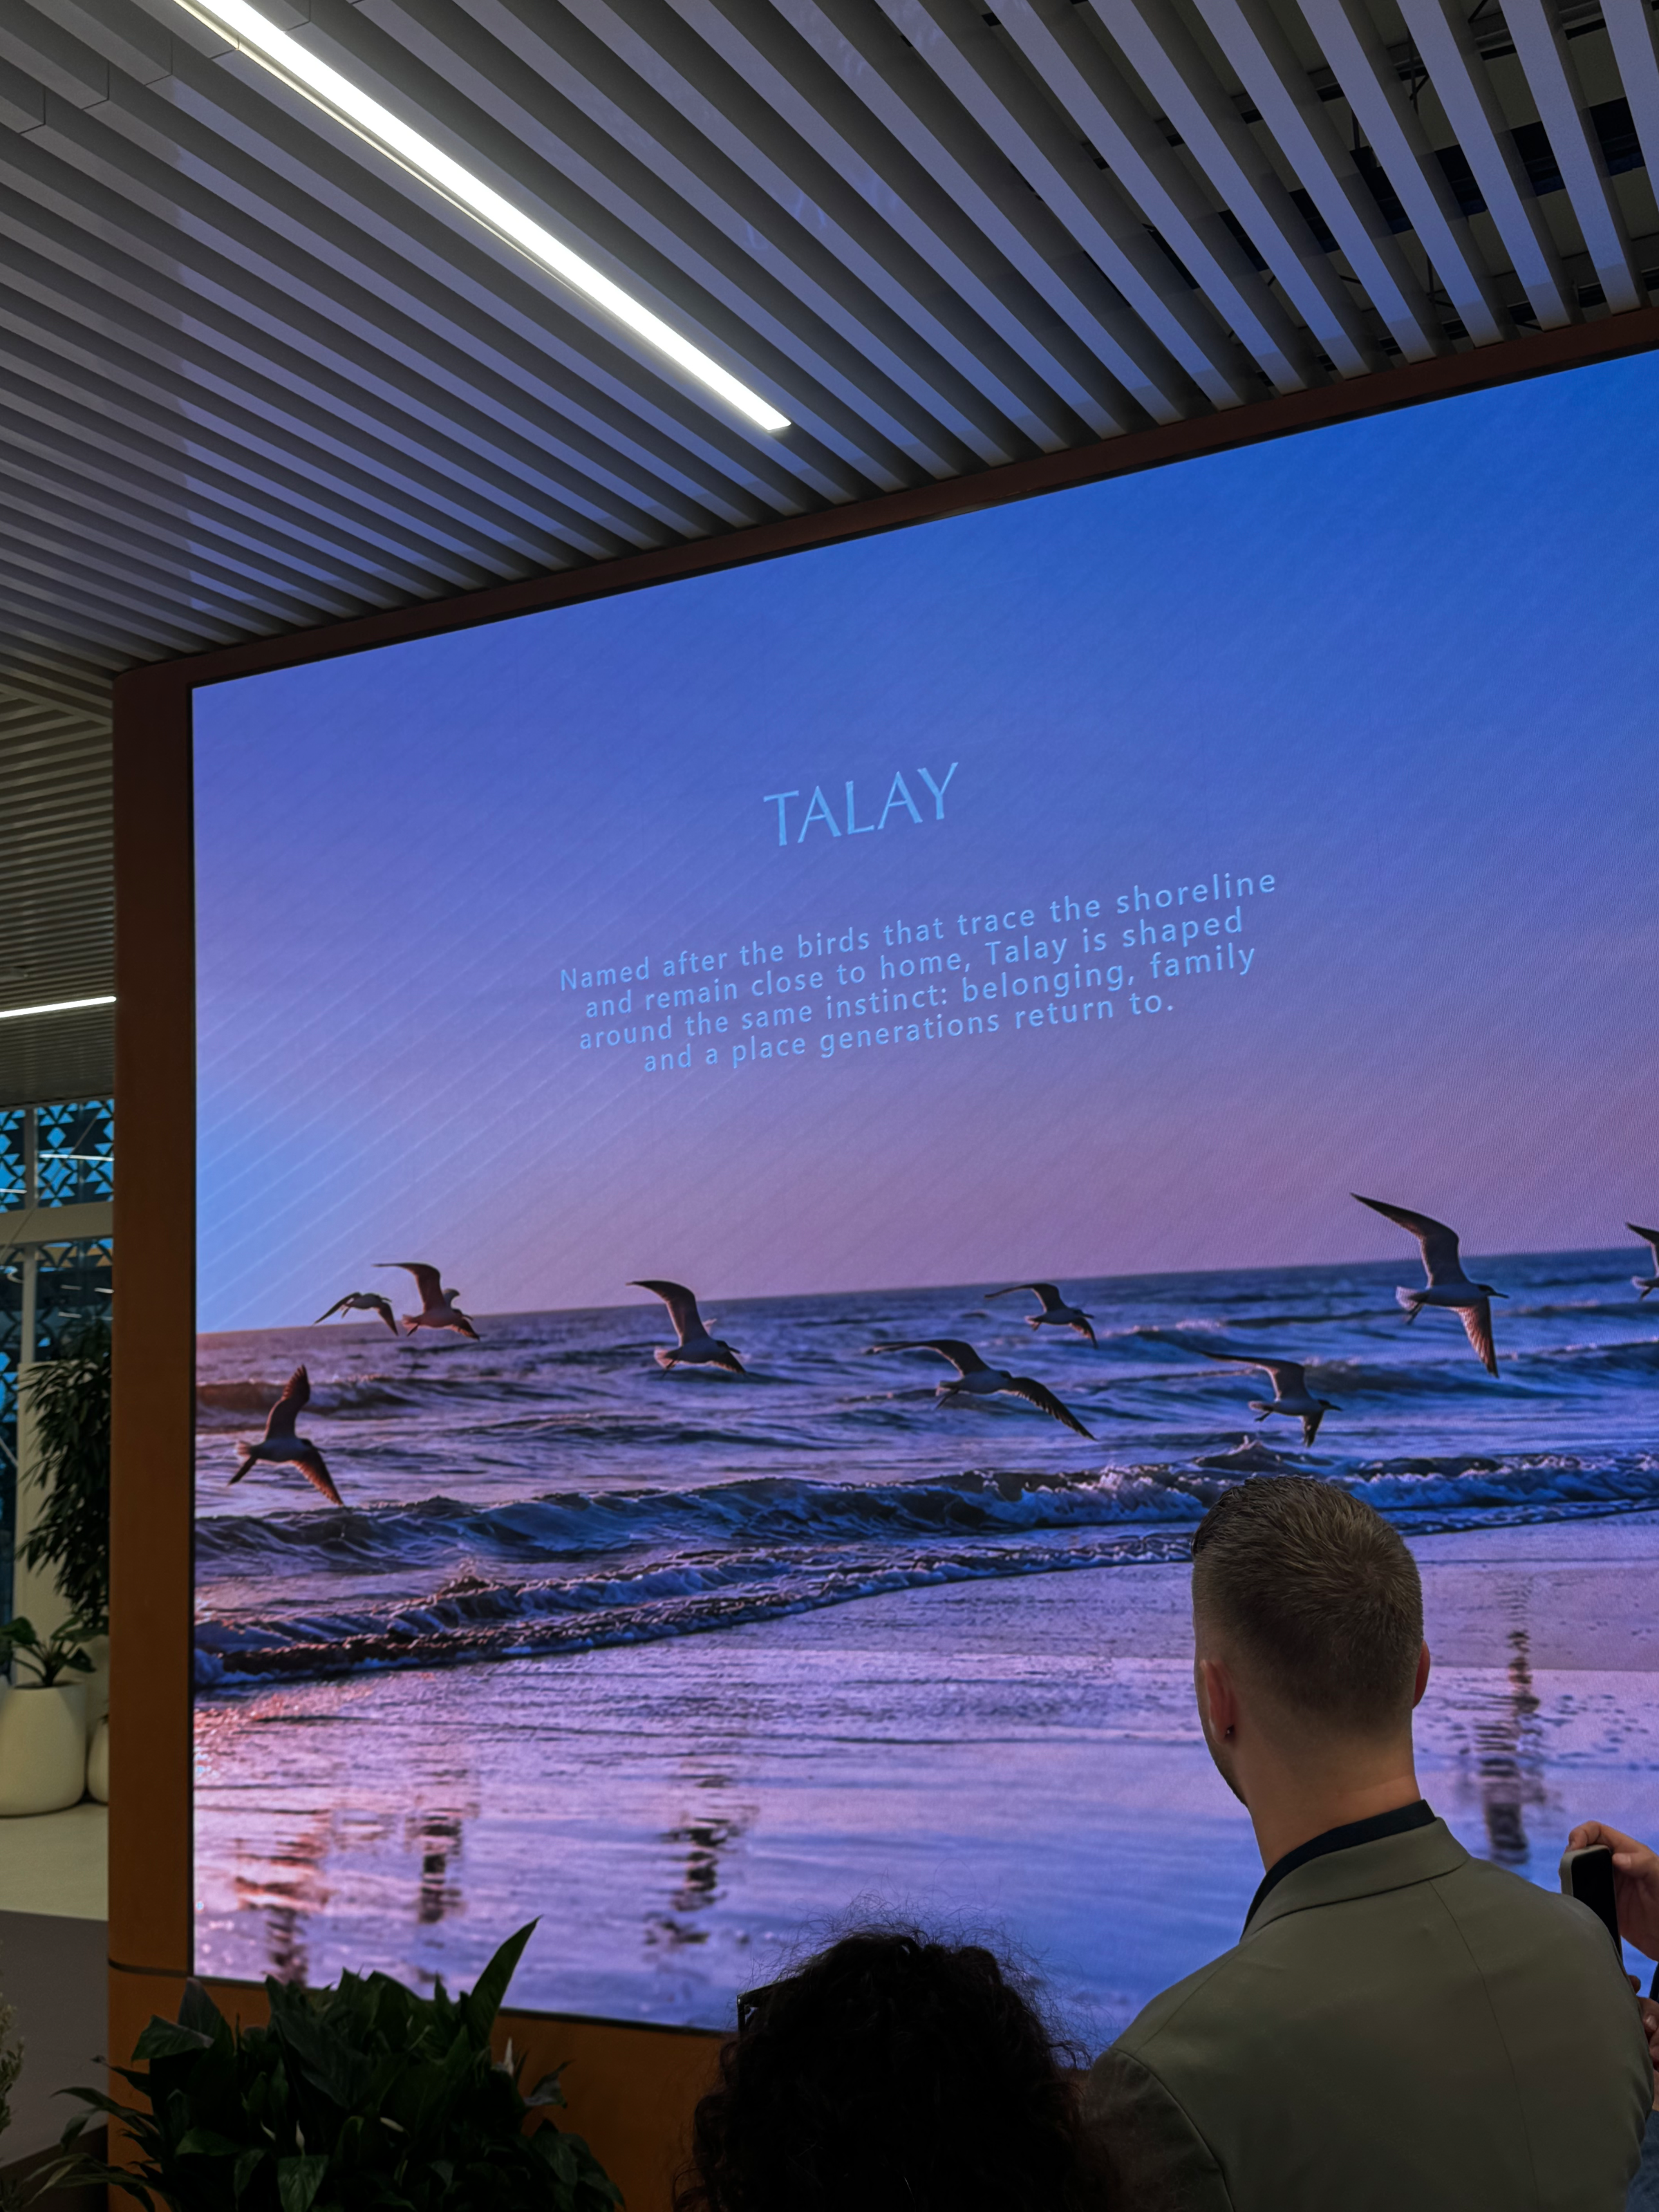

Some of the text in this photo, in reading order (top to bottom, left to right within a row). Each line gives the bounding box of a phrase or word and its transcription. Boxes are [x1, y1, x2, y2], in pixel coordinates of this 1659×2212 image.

[762, 760, 959, 847] TALAY
[559, 872, 1276, 991] Named after the birds that trace the shoreline
[585, 906, 1242, 1018] and remain close to home, Talay is shaped
[579, 942, 1255, 1050] around the same instinct: belonging, family
[644, 993, 1174, 1072] and a place generations return to.
